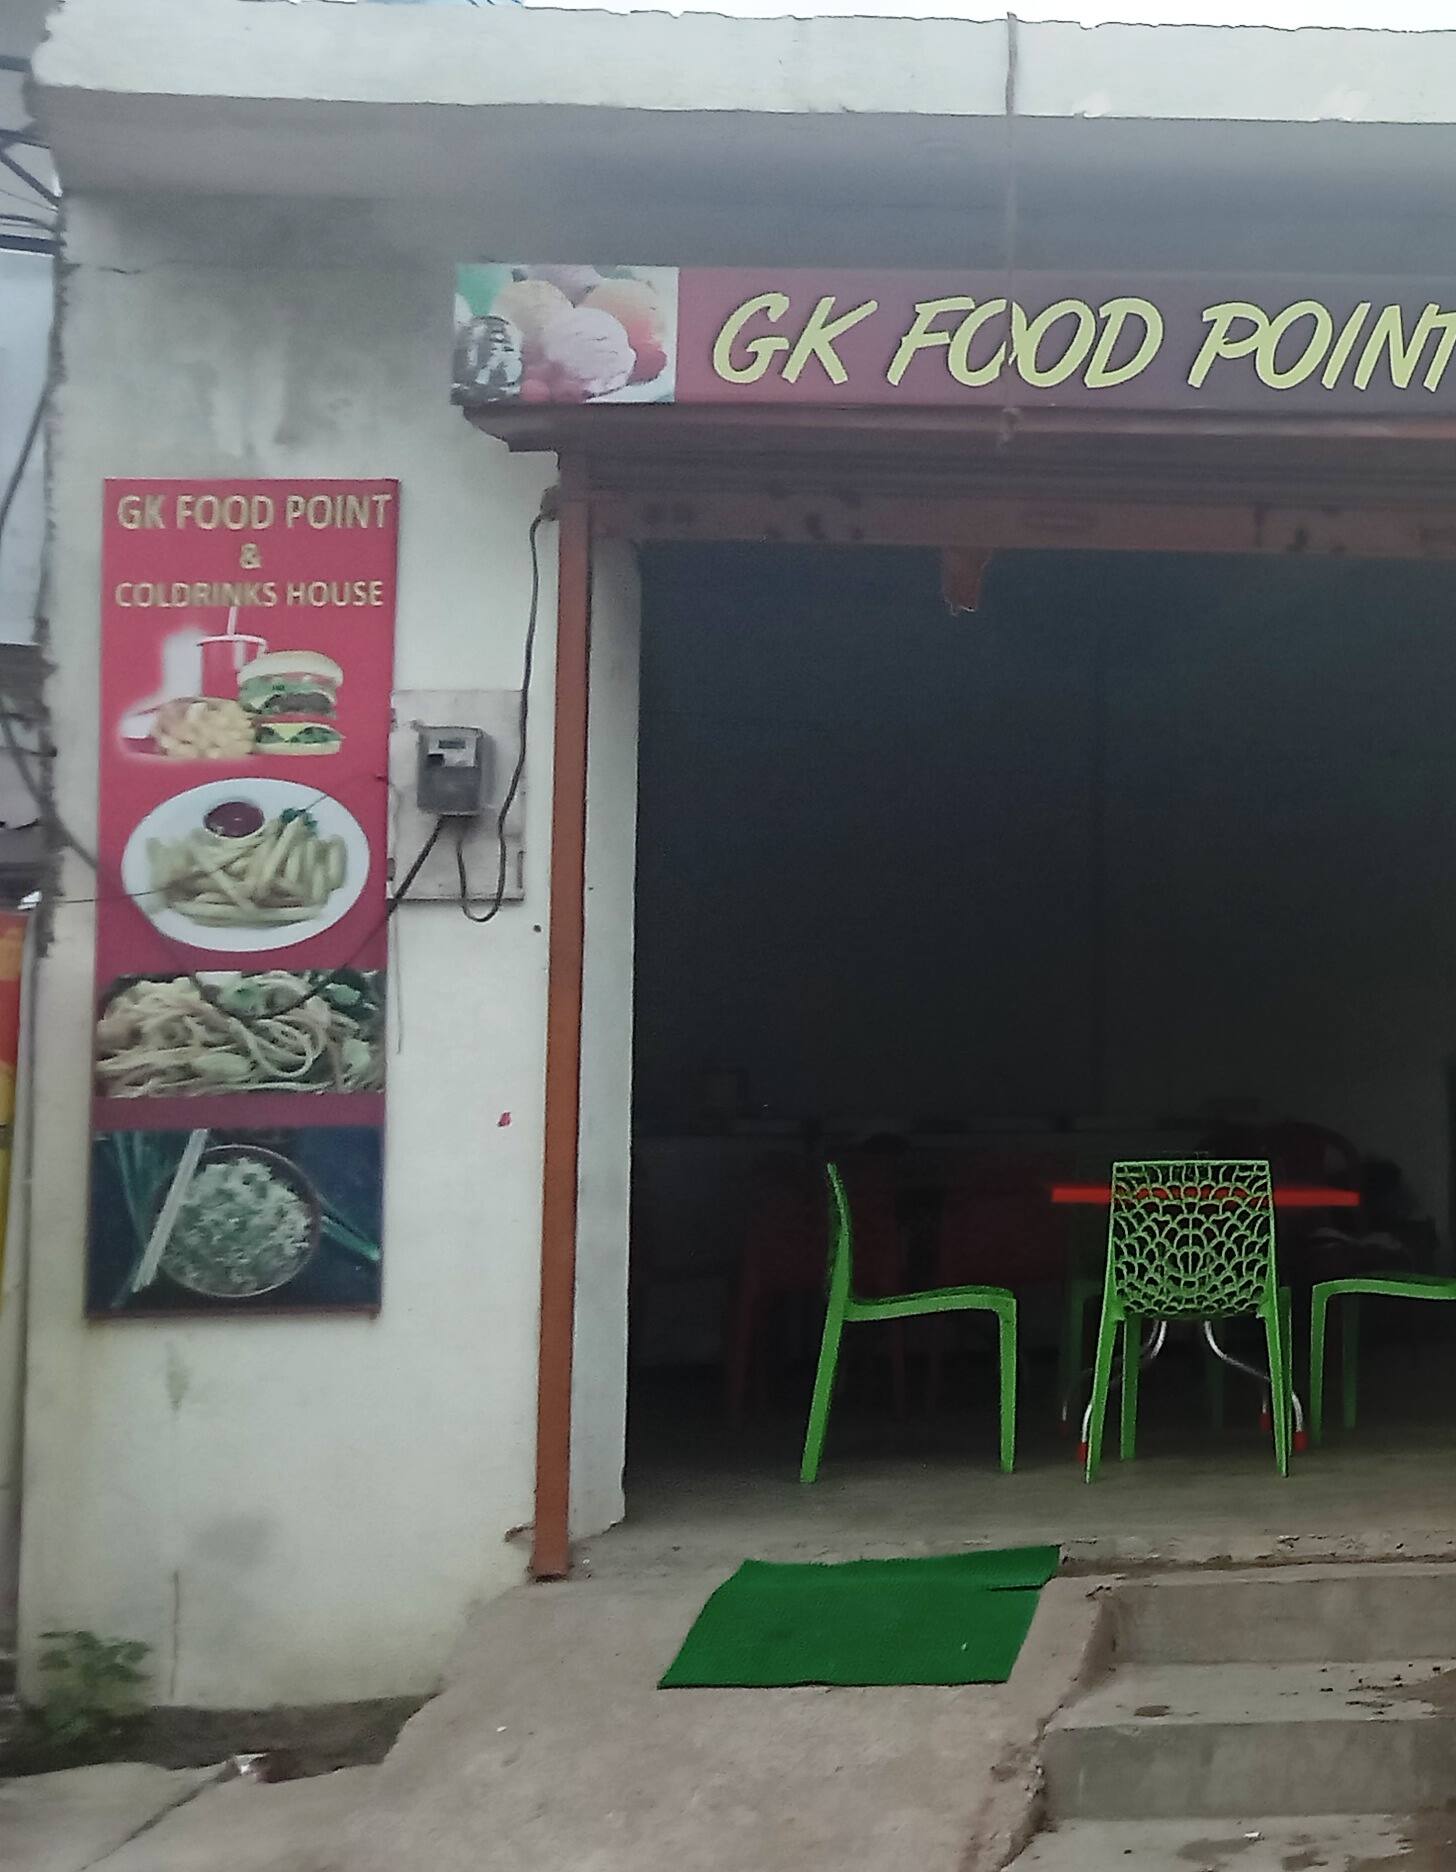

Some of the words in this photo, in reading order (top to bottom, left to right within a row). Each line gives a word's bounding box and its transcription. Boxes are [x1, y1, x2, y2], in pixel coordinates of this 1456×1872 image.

[713, 292, 878, 385] GK
[887, 295, 1164, 389] FOOD
[117, 495, 165, 529] GK
[176, 495, 275, 530] FOOD
[286, 494, 392, 529] POINT
[239, 543, 262, 569] &
[115, 582, 278, 607] COLDRINKS
[287, 581, 384, 607] HOUSE
